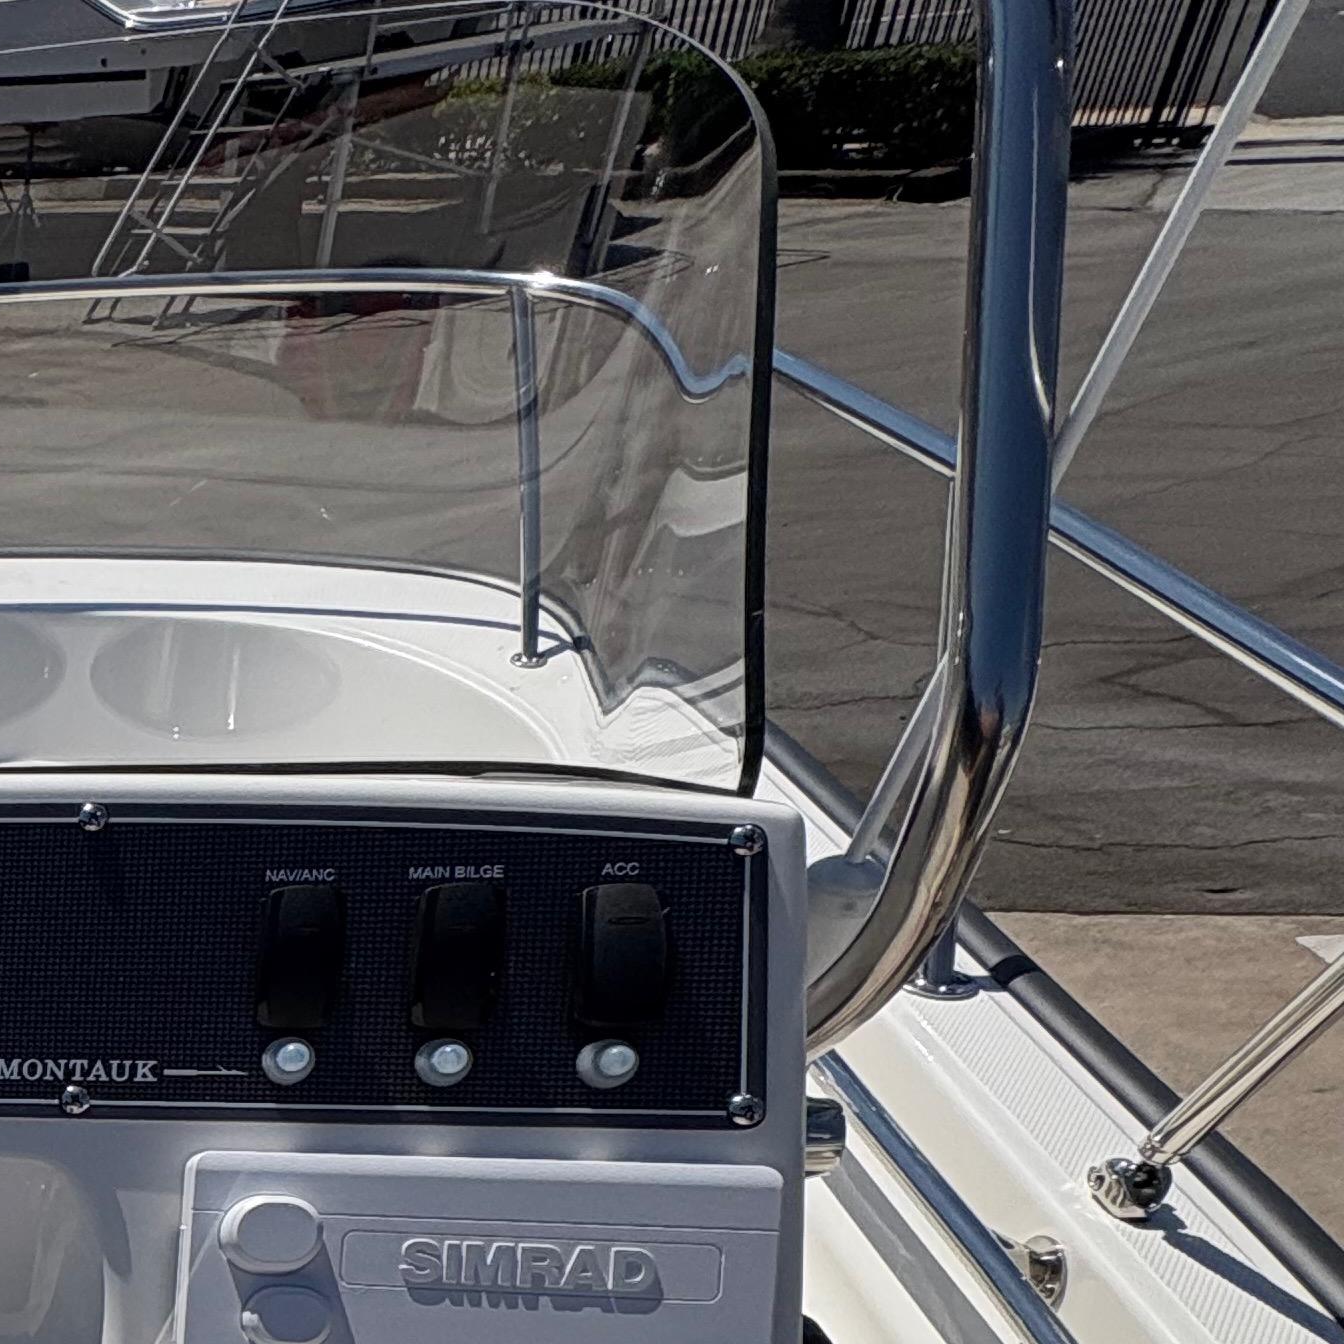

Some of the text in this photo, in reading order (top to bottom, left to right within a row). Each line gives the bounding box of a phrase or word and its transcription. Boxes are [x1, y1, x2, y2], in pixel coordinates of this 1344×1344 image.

[265, 867, 336, 883] NAV/ANC
[409, 864, 505, 880] MAIN BILGE
[601, 862, 640, 876] ACC
[398, 1237, 658, 1293] SIMRAD
